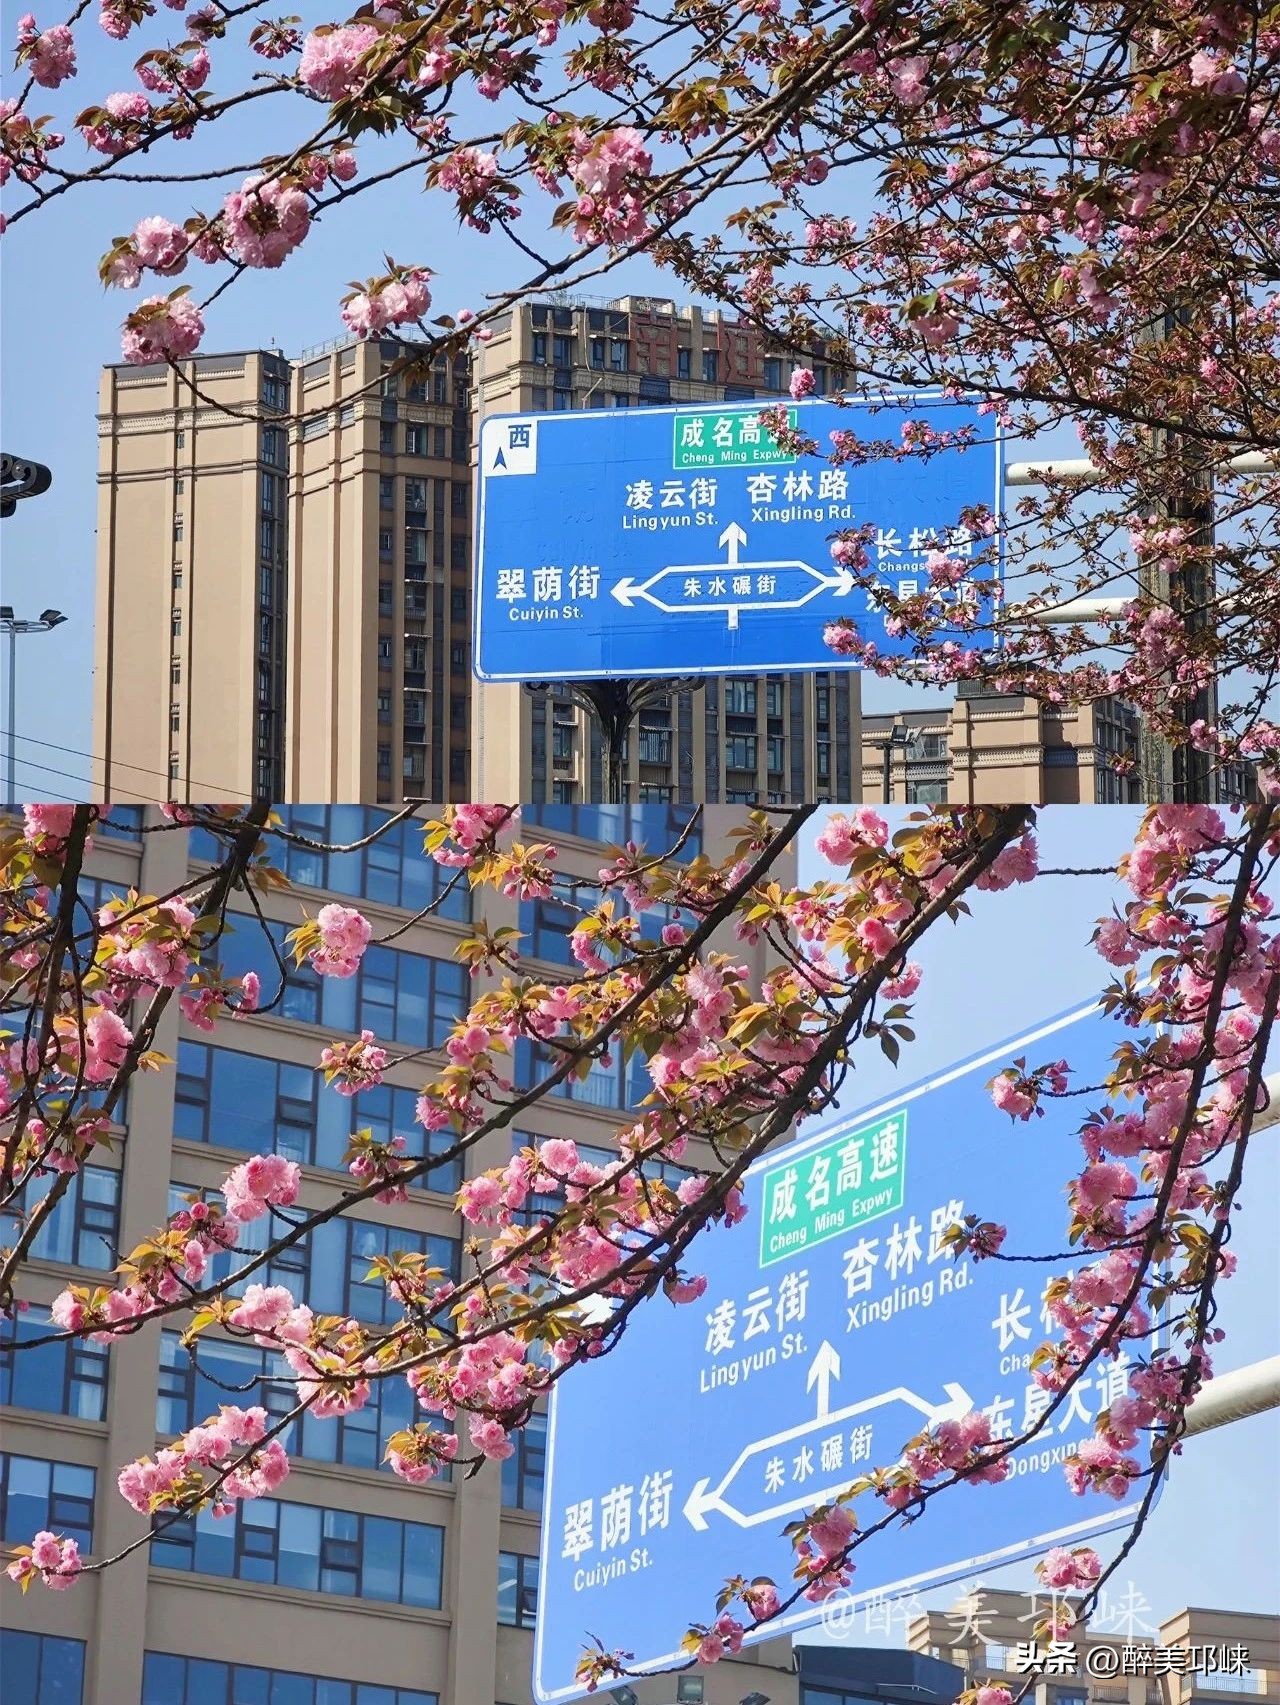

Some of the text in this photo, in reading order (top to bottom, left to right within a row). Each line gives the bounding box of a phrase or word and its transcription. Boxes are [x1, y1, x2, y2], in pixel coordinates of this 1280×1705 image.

[507, 424, 532, 449] 西
[681, 414, 790, 447] 成名高
[682, 452, 714, 464] Cheng
[721, 450, 747, 462] Ming
[626, 478, 717, 510] 凌云街
[747, 469, 849, 503] 杏林路
[695, 512, 718, 525] St.
[751, 505, 856, 523] Xingling Rd.
[496, 565, 600, 603] 翠荫街
[684, 575, 776, 598] 朱水碾街
[509, 605, 584, 622] Cuiyin St.
[769, 1121, 900, 1225] 成名高速
[770, 1187, 894, 1254] Cheng Ming Expwy
[842, 1199, 966, 1299] 杏林路
[704, 1269, 809, 1357] 凌云街
[846, 1262, 974, 1334] Xingling Rd.
[781, 1331, 808, 1360] St.
[765, 1424, 873, 1494] 朱水碾街
[562, 1469, 673, 1563] 翠荫街
[574, 1548, 653, 1593] Cuiyin St.
